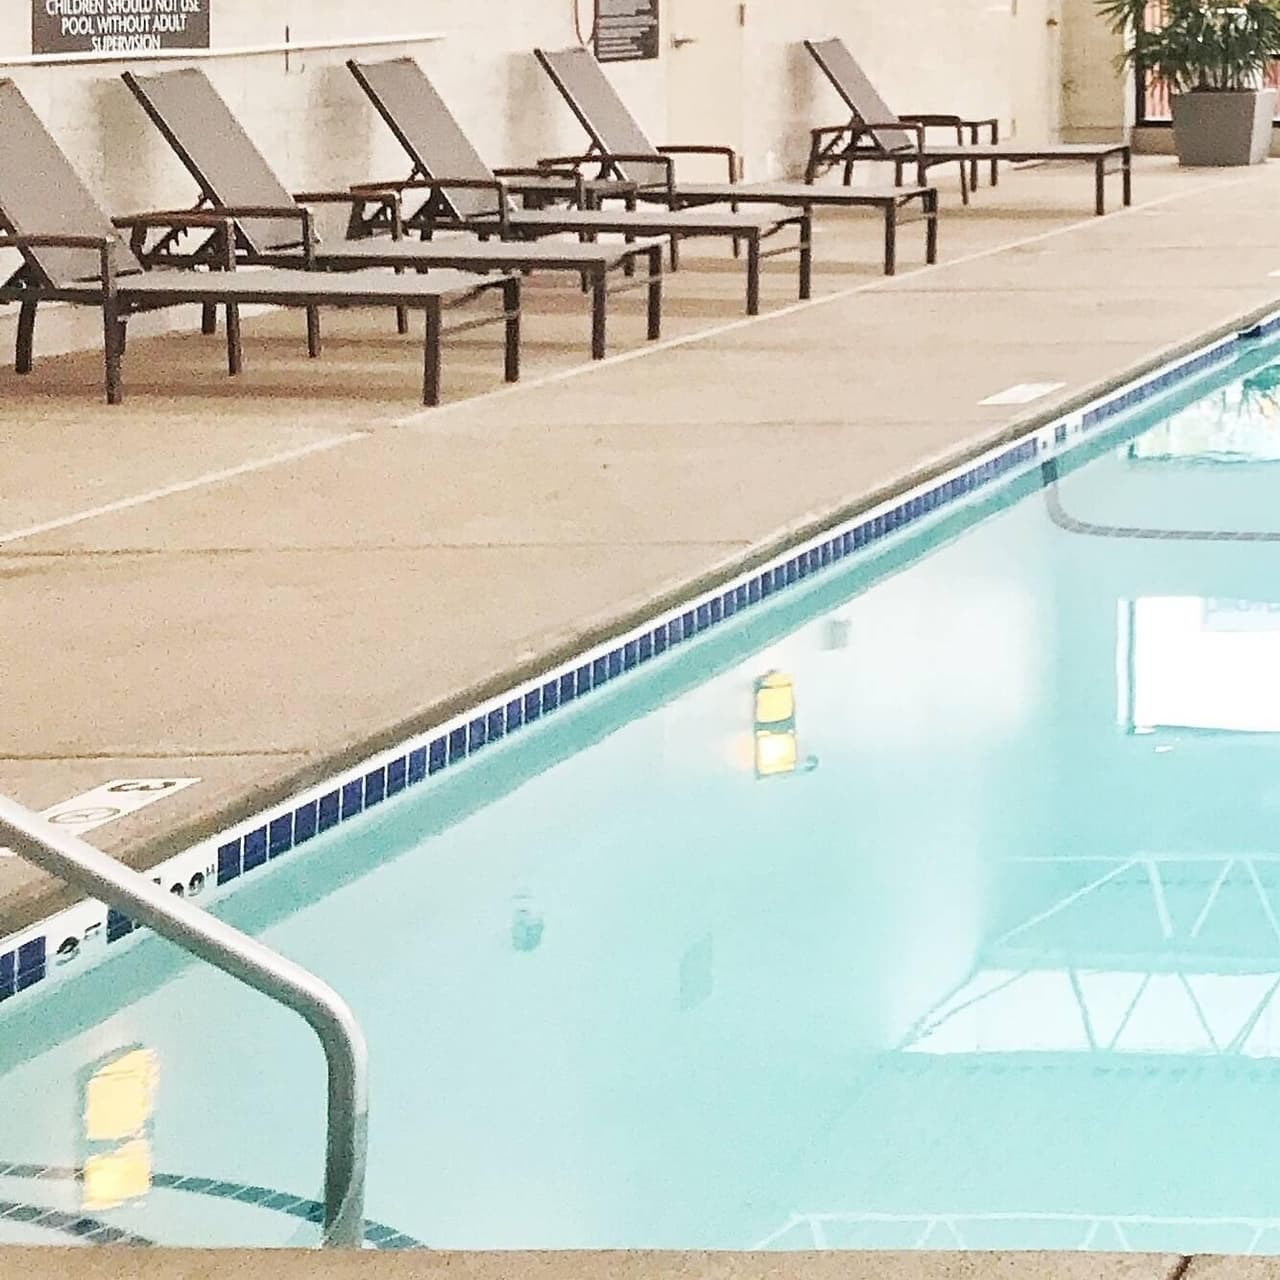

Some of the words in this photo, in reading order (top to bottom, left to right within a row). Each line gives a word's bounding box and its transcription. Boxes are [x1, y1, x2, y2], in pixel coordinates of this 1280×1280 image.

[61, 16, 95, 35] POOL
[97, 15, 151, 34] WITHOUT
[152, 13, 187, 32] ADULT
[91, 34, 161, 51] SUPERVISION
